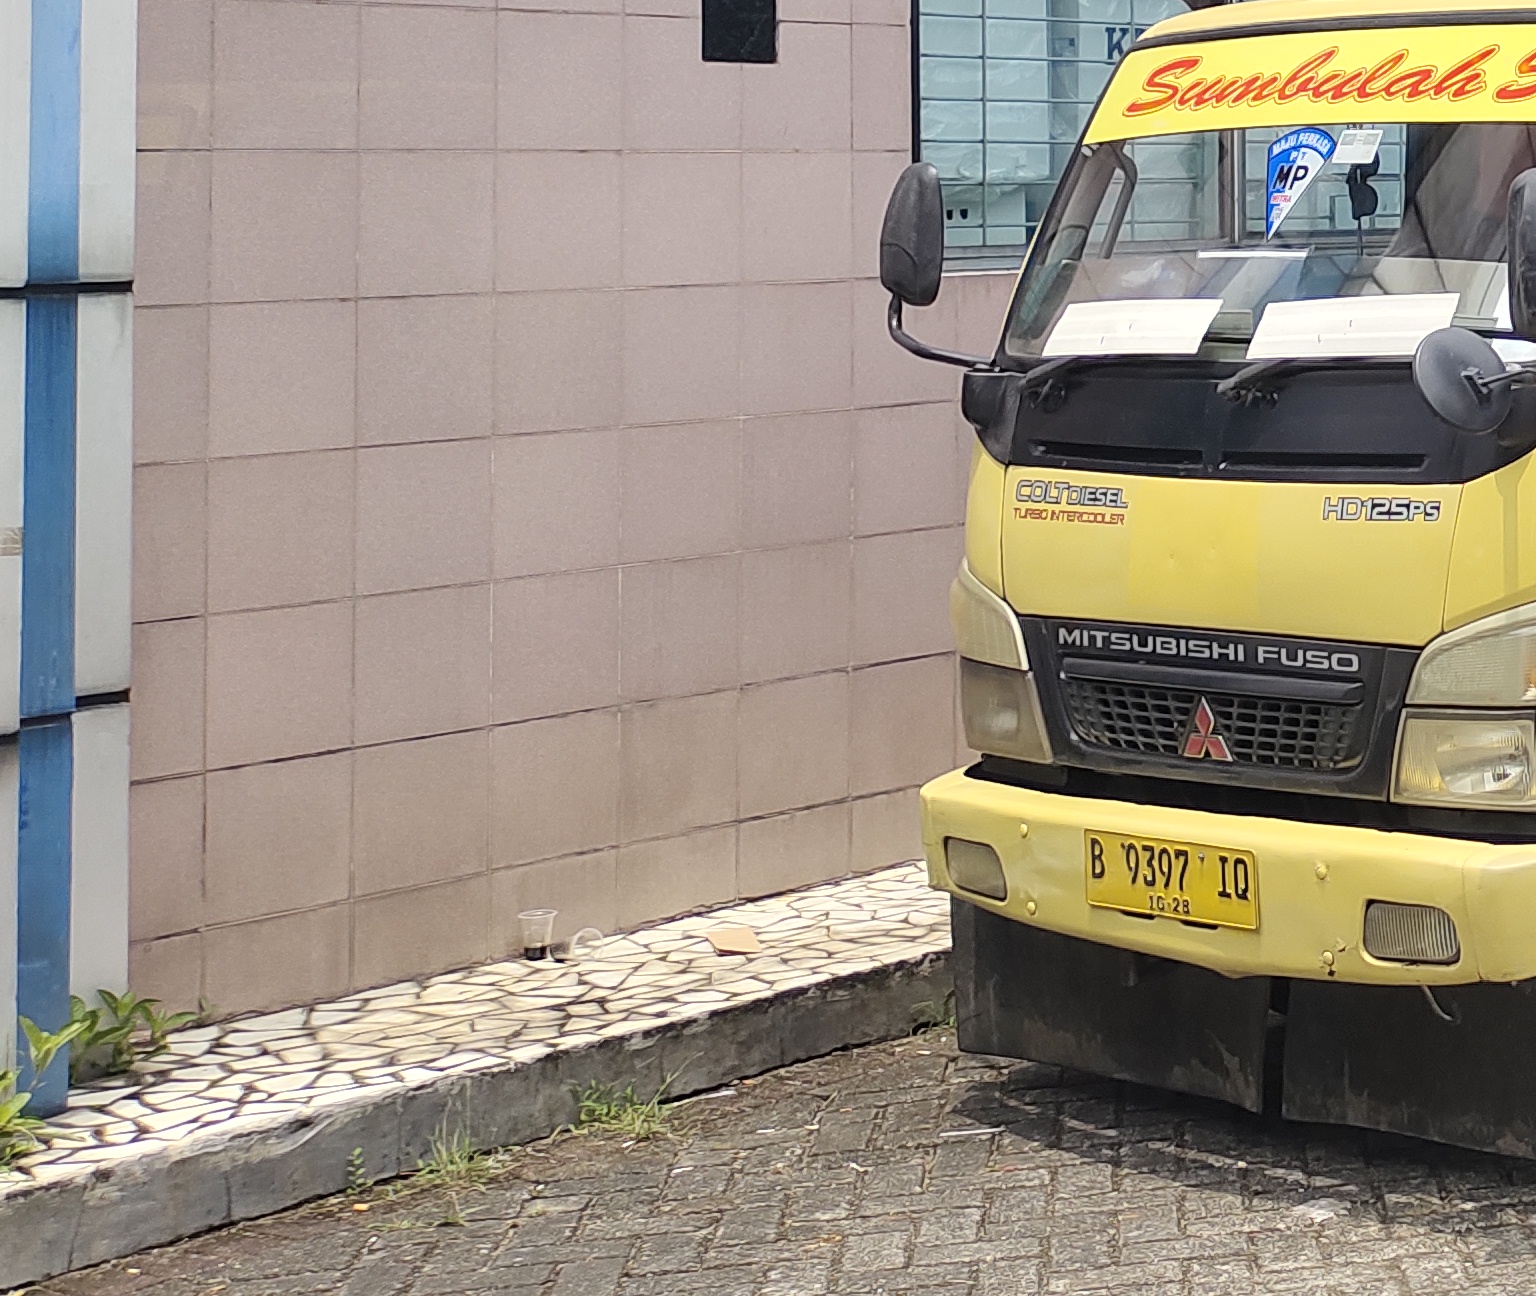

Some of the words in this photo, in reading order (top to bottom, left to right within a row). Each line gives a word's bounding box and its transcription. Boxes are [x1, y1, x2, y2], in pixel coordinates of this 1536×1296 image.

[1122, 44, 1501, 117] Sumbulah
[1271, 165, 1309, 191] MP
[1014, 507, 1049, 521] TURBO
[1050, 509, 1125, 526] INTERCOOLER
[1058, 627, 1245, 663] MITSUBISHI
[1257, 645, 1360, 672] FUSO
[1089, 837, 1106, 880] B
[1124, 841, 1190, 893] 9397
[1217, 854, 1251, 902] IQ
